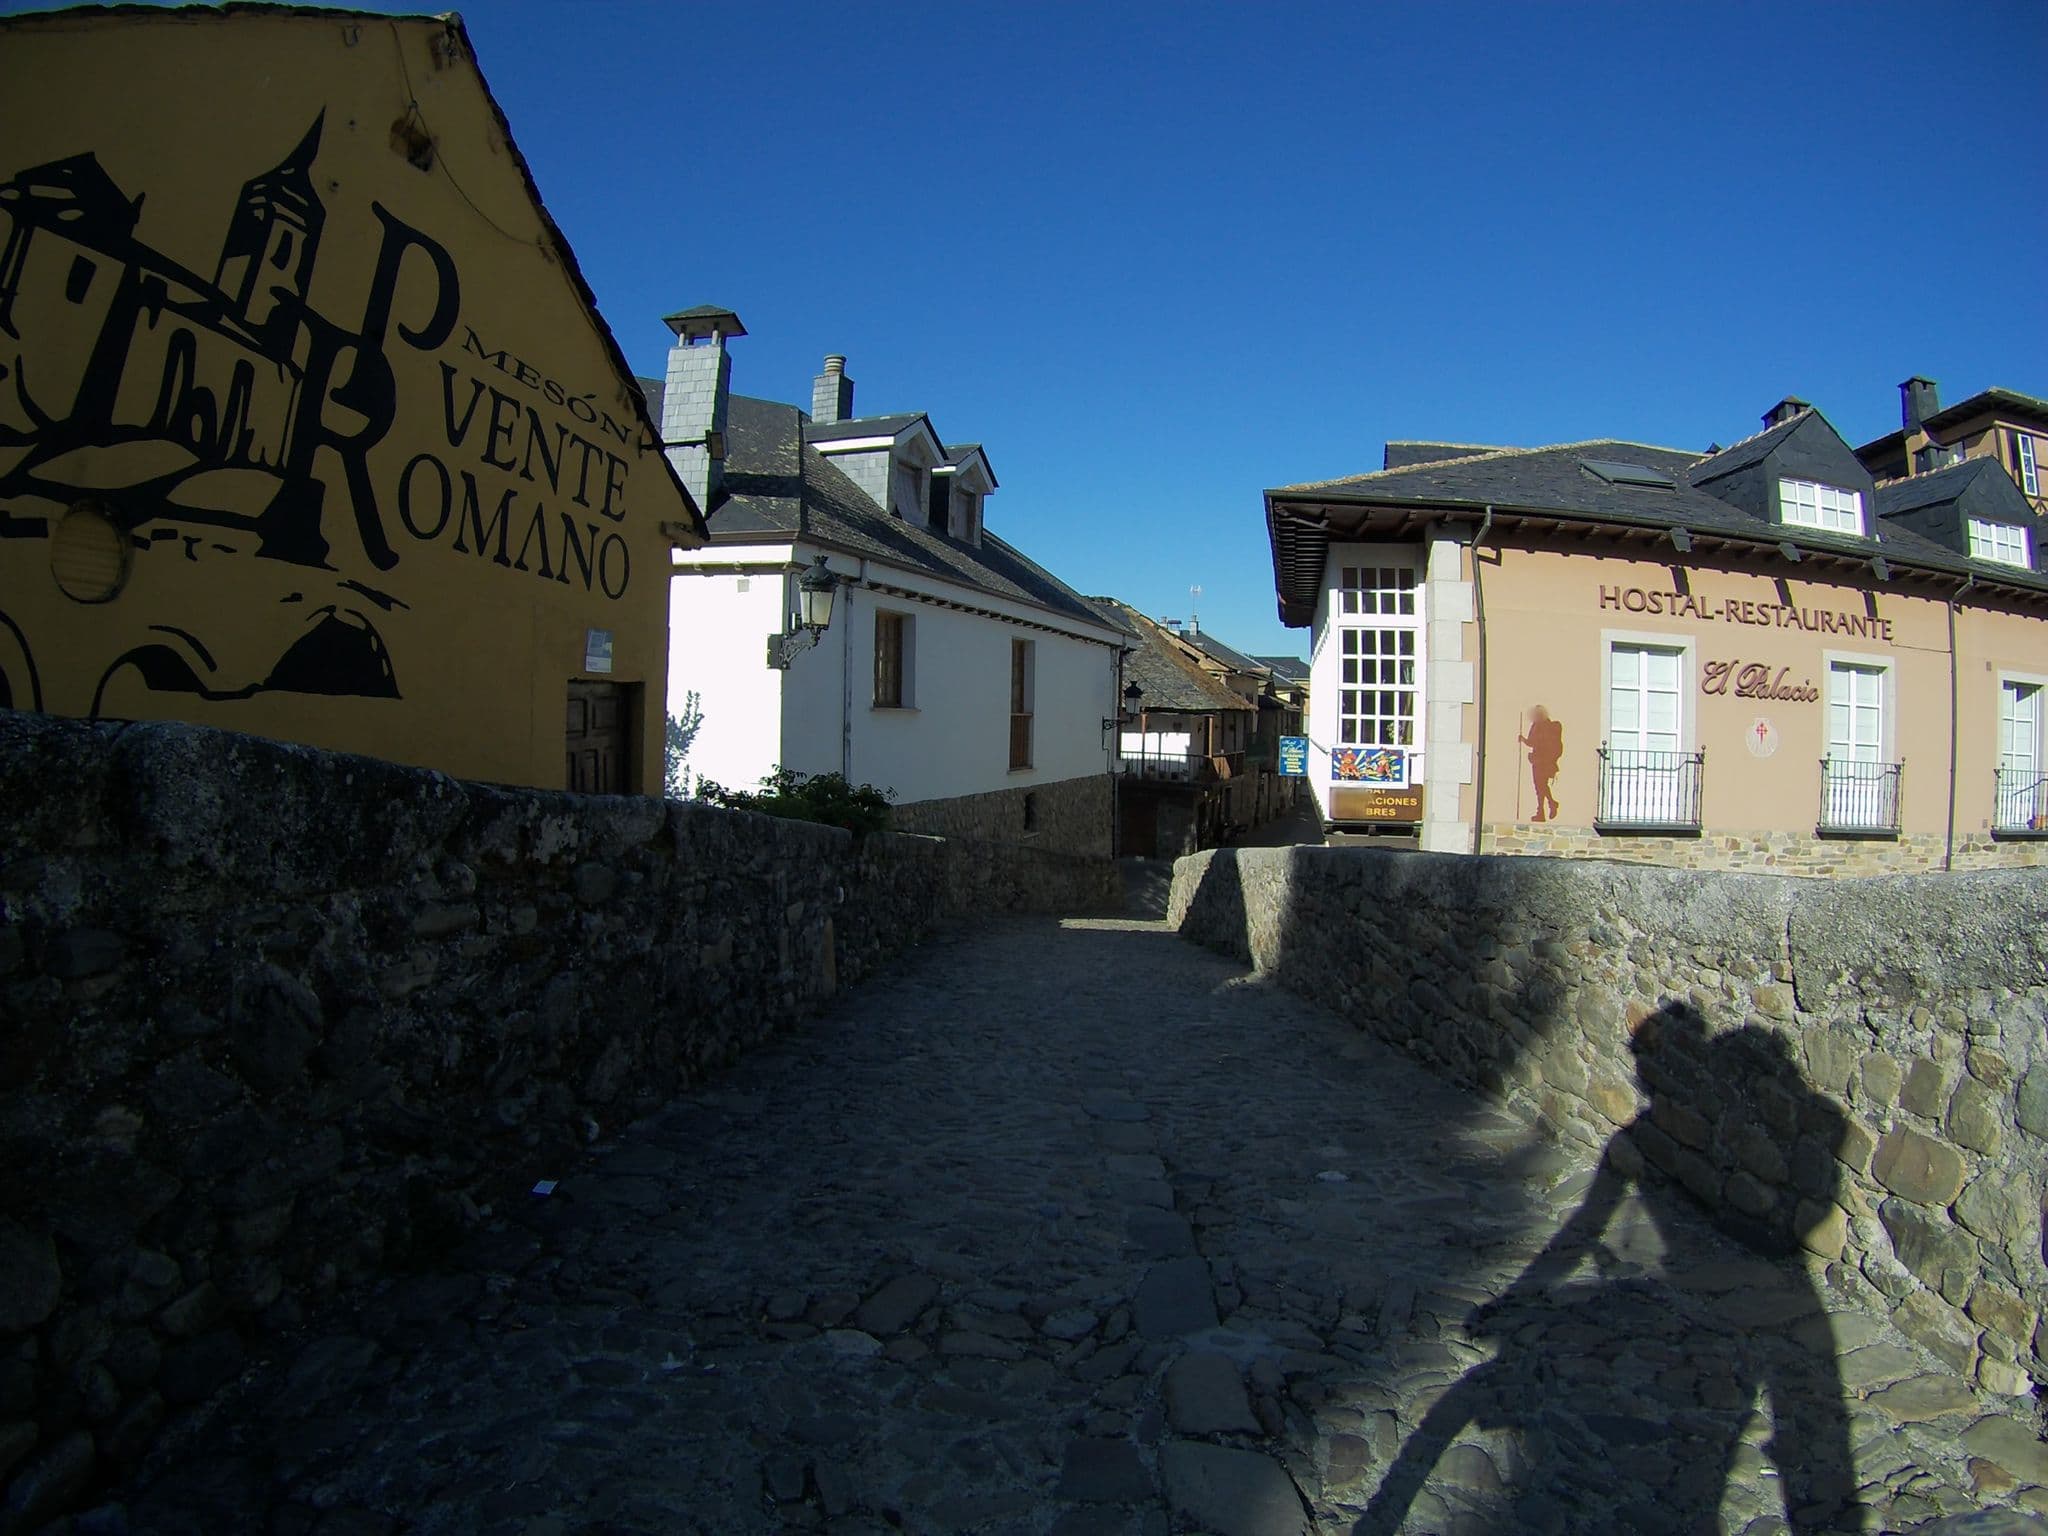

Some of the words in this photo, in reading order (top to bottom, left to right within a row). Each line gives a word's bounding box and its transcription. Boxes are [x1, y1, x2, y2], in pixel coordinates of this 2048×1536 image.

[463, 326, 632, 445] MESÓN
[276, 315, 630, 600] ROMANO
[1599, 585, 1893, 640] HOSTAL-RESTAURANTE
[1701, 659, 1740, 696] El
[1735, 663, 1819, 703] Palacio
